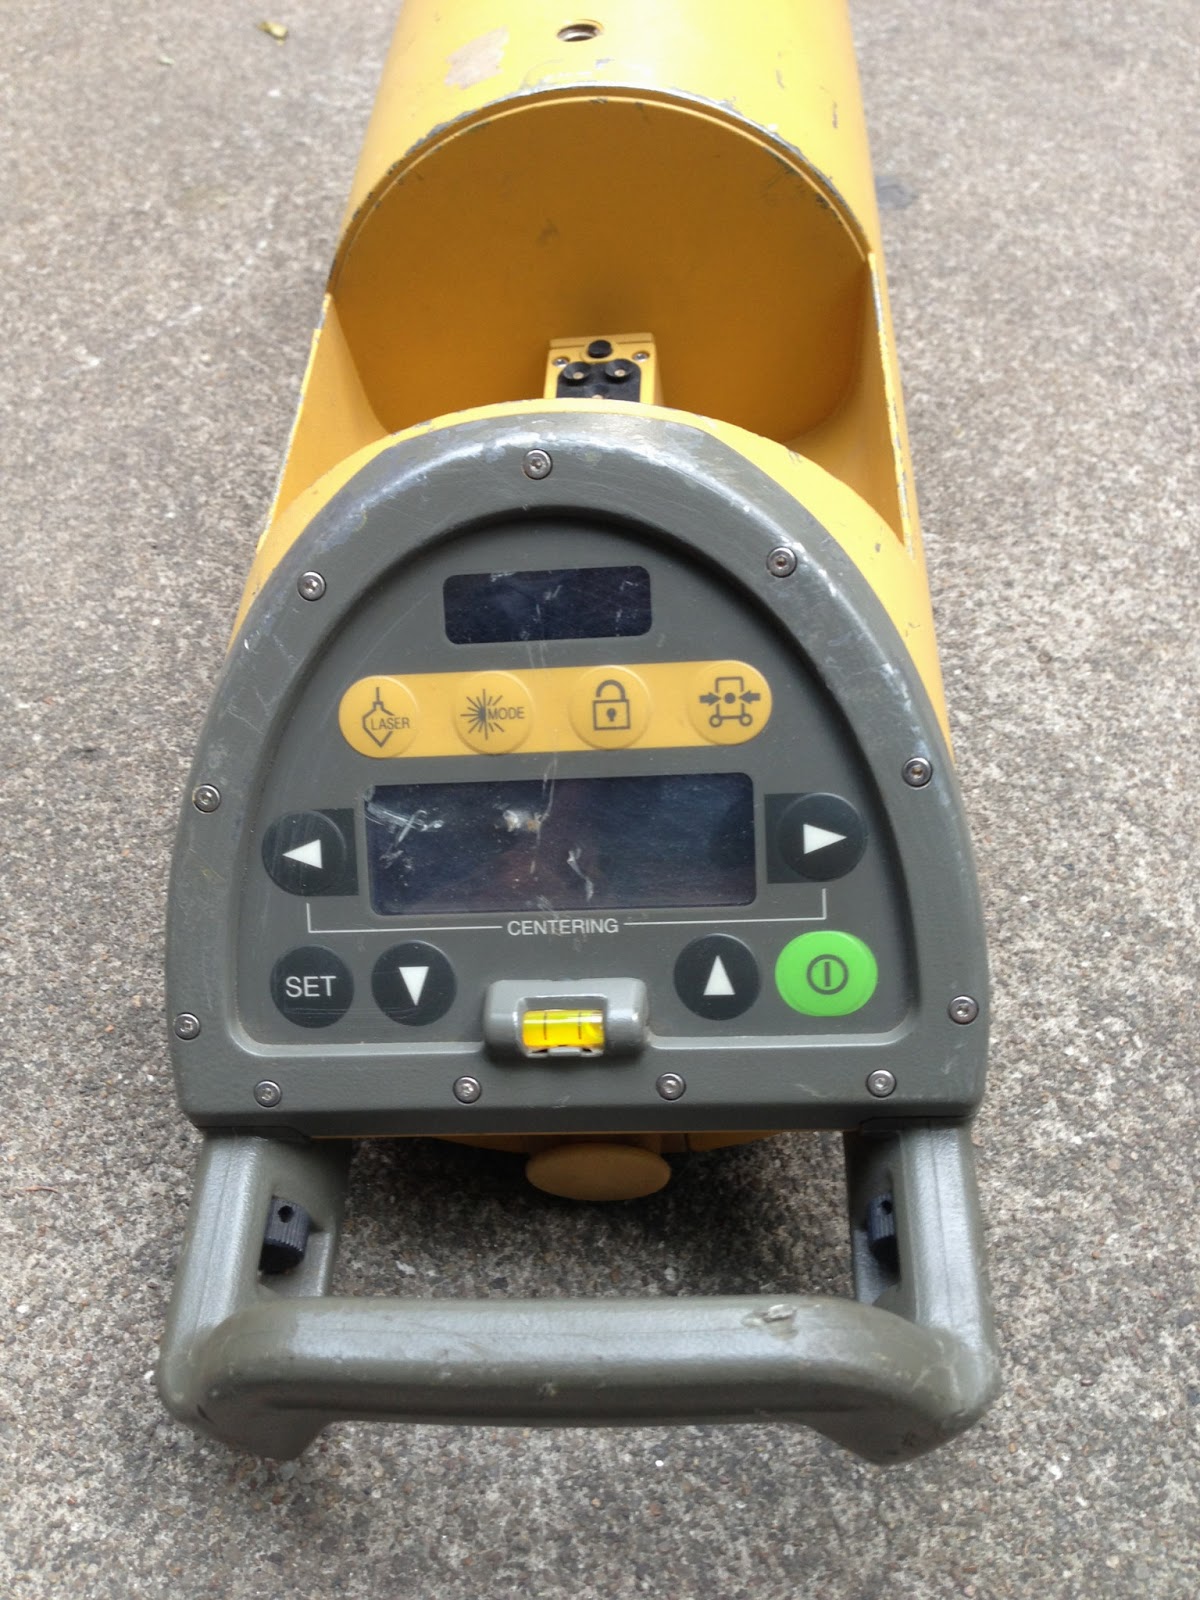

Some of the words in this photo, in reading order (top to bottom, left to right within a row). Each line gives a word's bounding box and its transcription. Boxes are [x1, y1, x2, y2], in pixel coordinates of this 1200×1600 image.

[487, 706, 525, 721] MODE
[370, 716, 410, 731] LASER
[507, 918, 619, 936] CENTERING
[285, 976, 337, 998] SET
